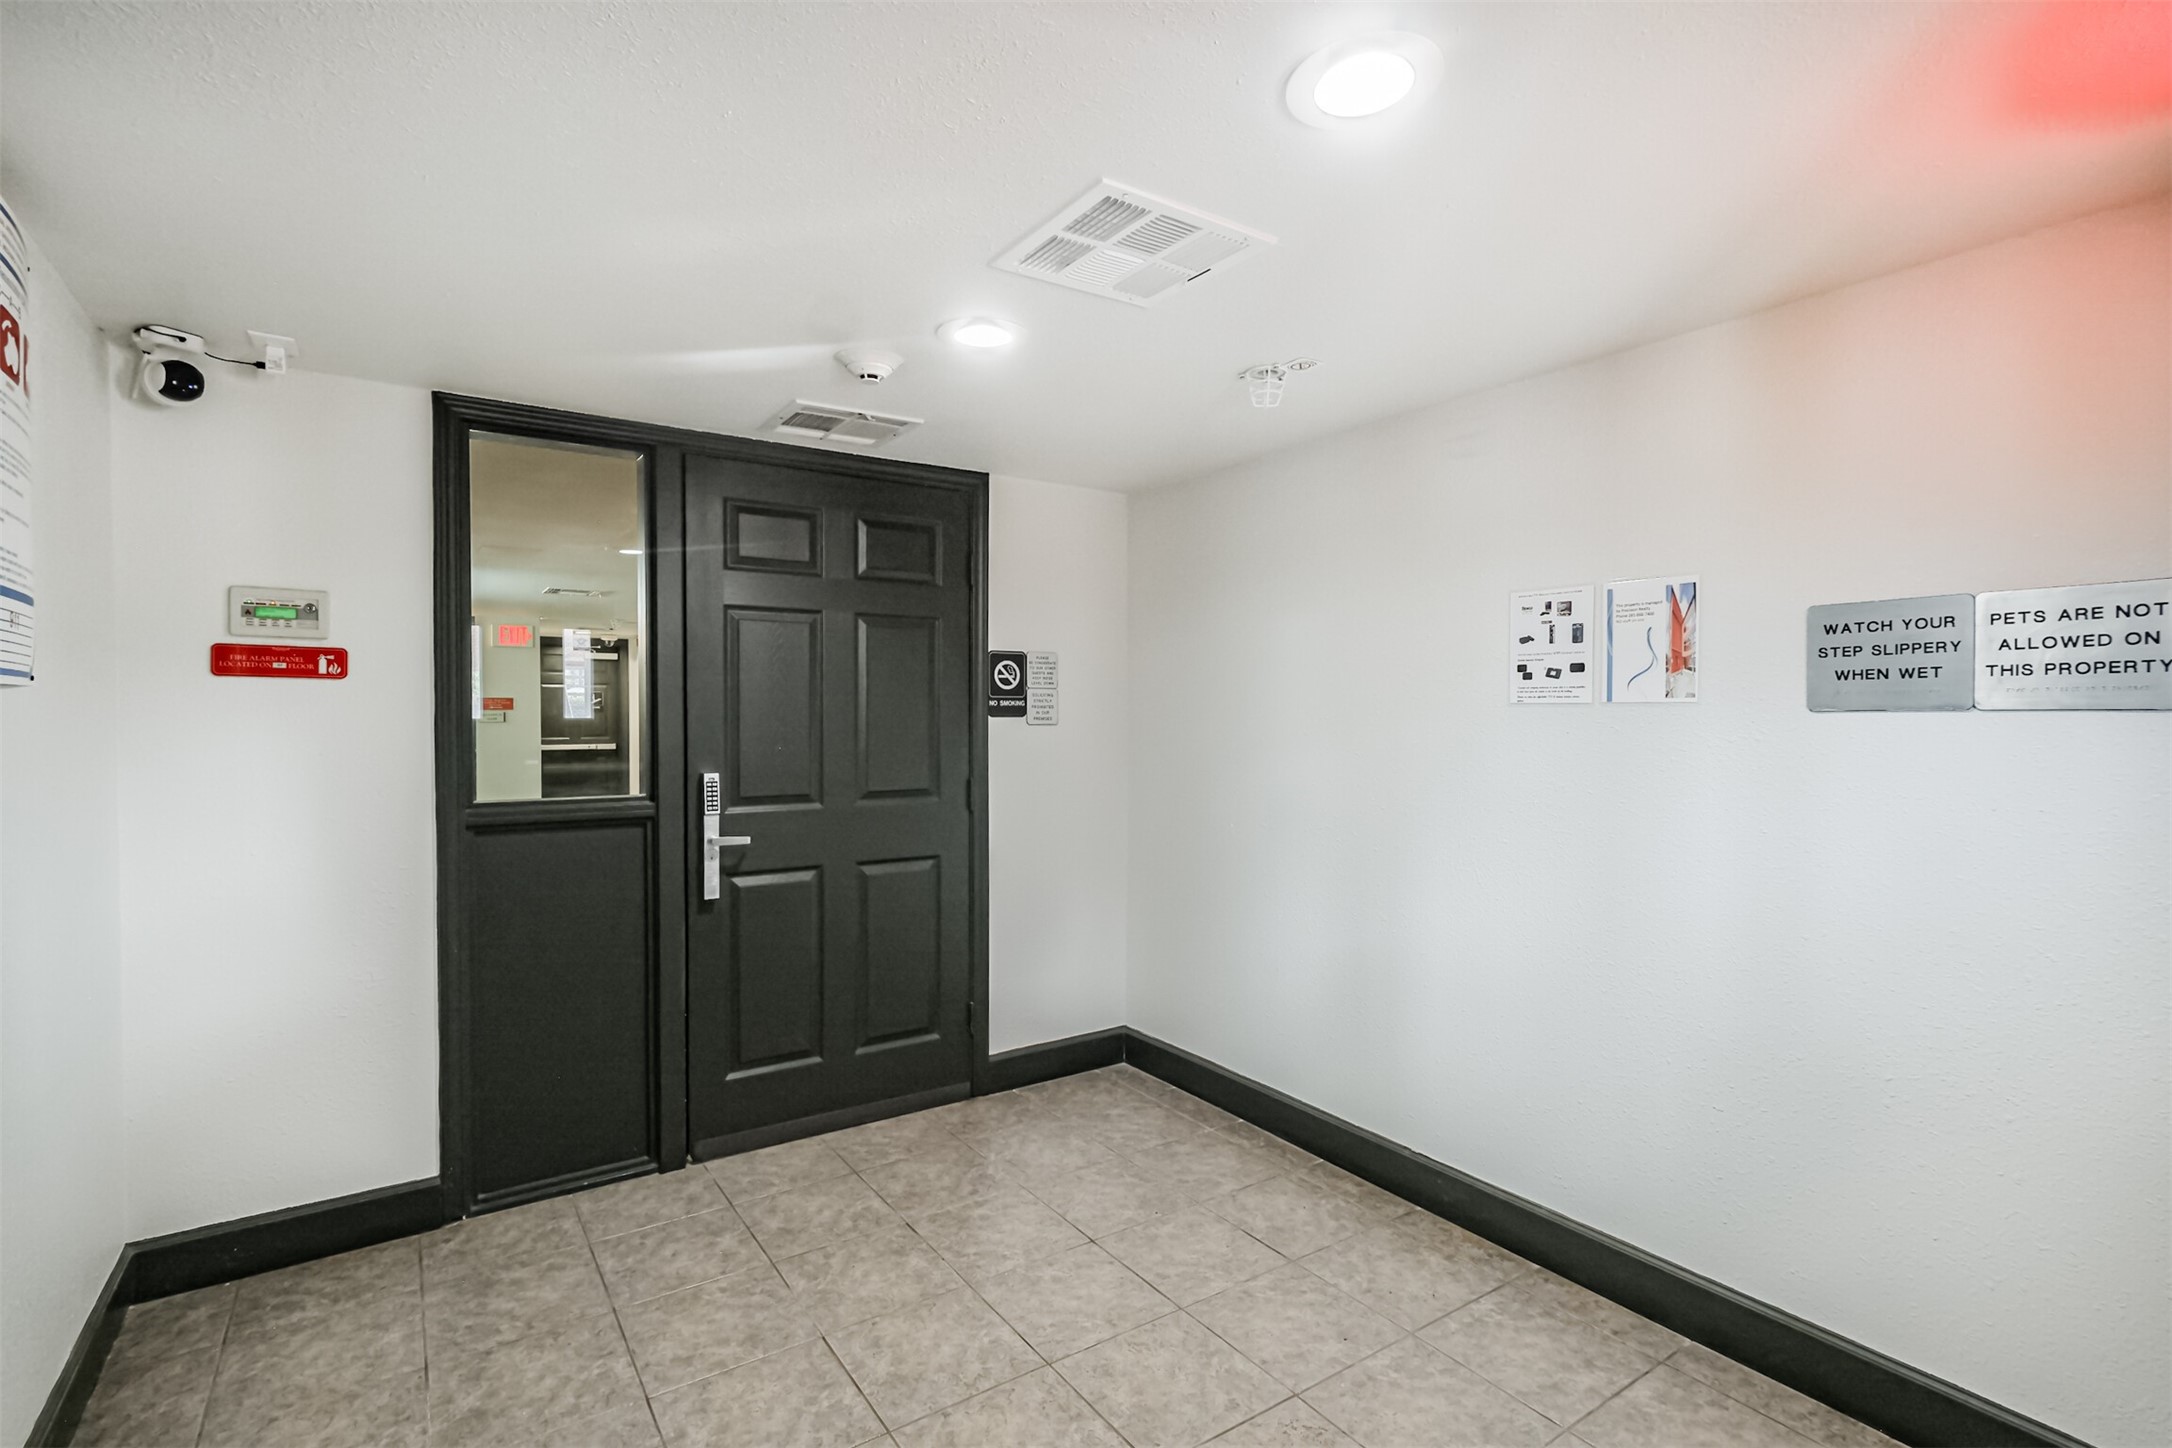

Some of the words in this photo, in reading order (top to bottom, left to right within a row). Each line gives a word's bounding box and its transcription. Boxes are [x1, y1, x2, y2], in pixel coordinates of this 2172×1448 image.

[1990, 611, 2046, 625] PETS
[2058, 606, 2104, 622] ARE
[2115, 601, 2169, 618] NOT
[1823, 620, 1893, 636] WATCH
[1902, 616, 1955, 631] YOUR
[1818, 645, 1863, 659] STEP
[1872, 640, 1962, 657] SLIPPERY
[1999, 633, 2112, 651] ALLOWED
[2124, 630, 2160, 645] ON
[1835, 668, 1889, 681] WHEN
[1898, 666, 1943, 680] WET
[1985, 663, 2033, 677] THIS
[2045, 658, 2172, 675] PROPERTY
